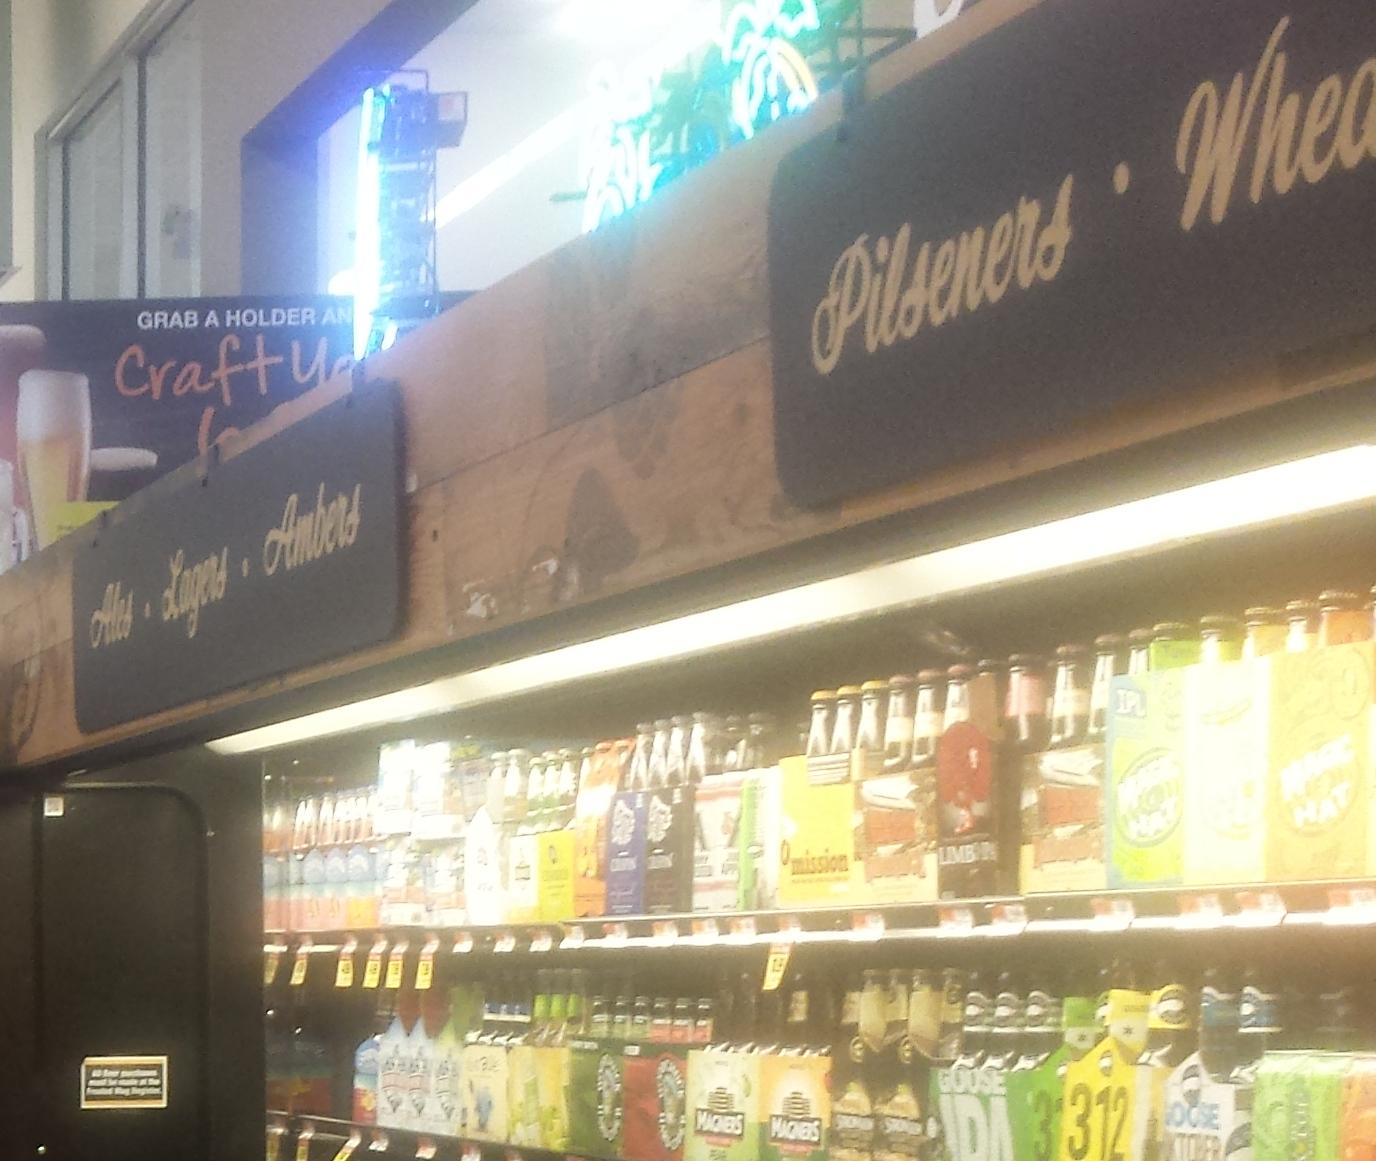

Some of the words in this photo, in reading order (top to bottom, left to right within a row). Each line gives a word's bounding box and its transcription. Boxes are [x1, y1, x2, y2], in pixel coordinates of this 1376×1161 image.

[812, 173, 1073, 375] Pilseners
[137, 308, 198, 330] GRAB
[204, 308, 220, 327] A
[226, 306, 316, 328] HOLDER
[322, 306, 354, 325] AN
[115, 334, 282, 405] Craft
[263, 482, 362, 576] Ambers
[1293, 782, 1352, 828] HAT
[696, 1110, 743, 1135] MAGNERS
[771, 1115, 821, 1144] MAGNERS
